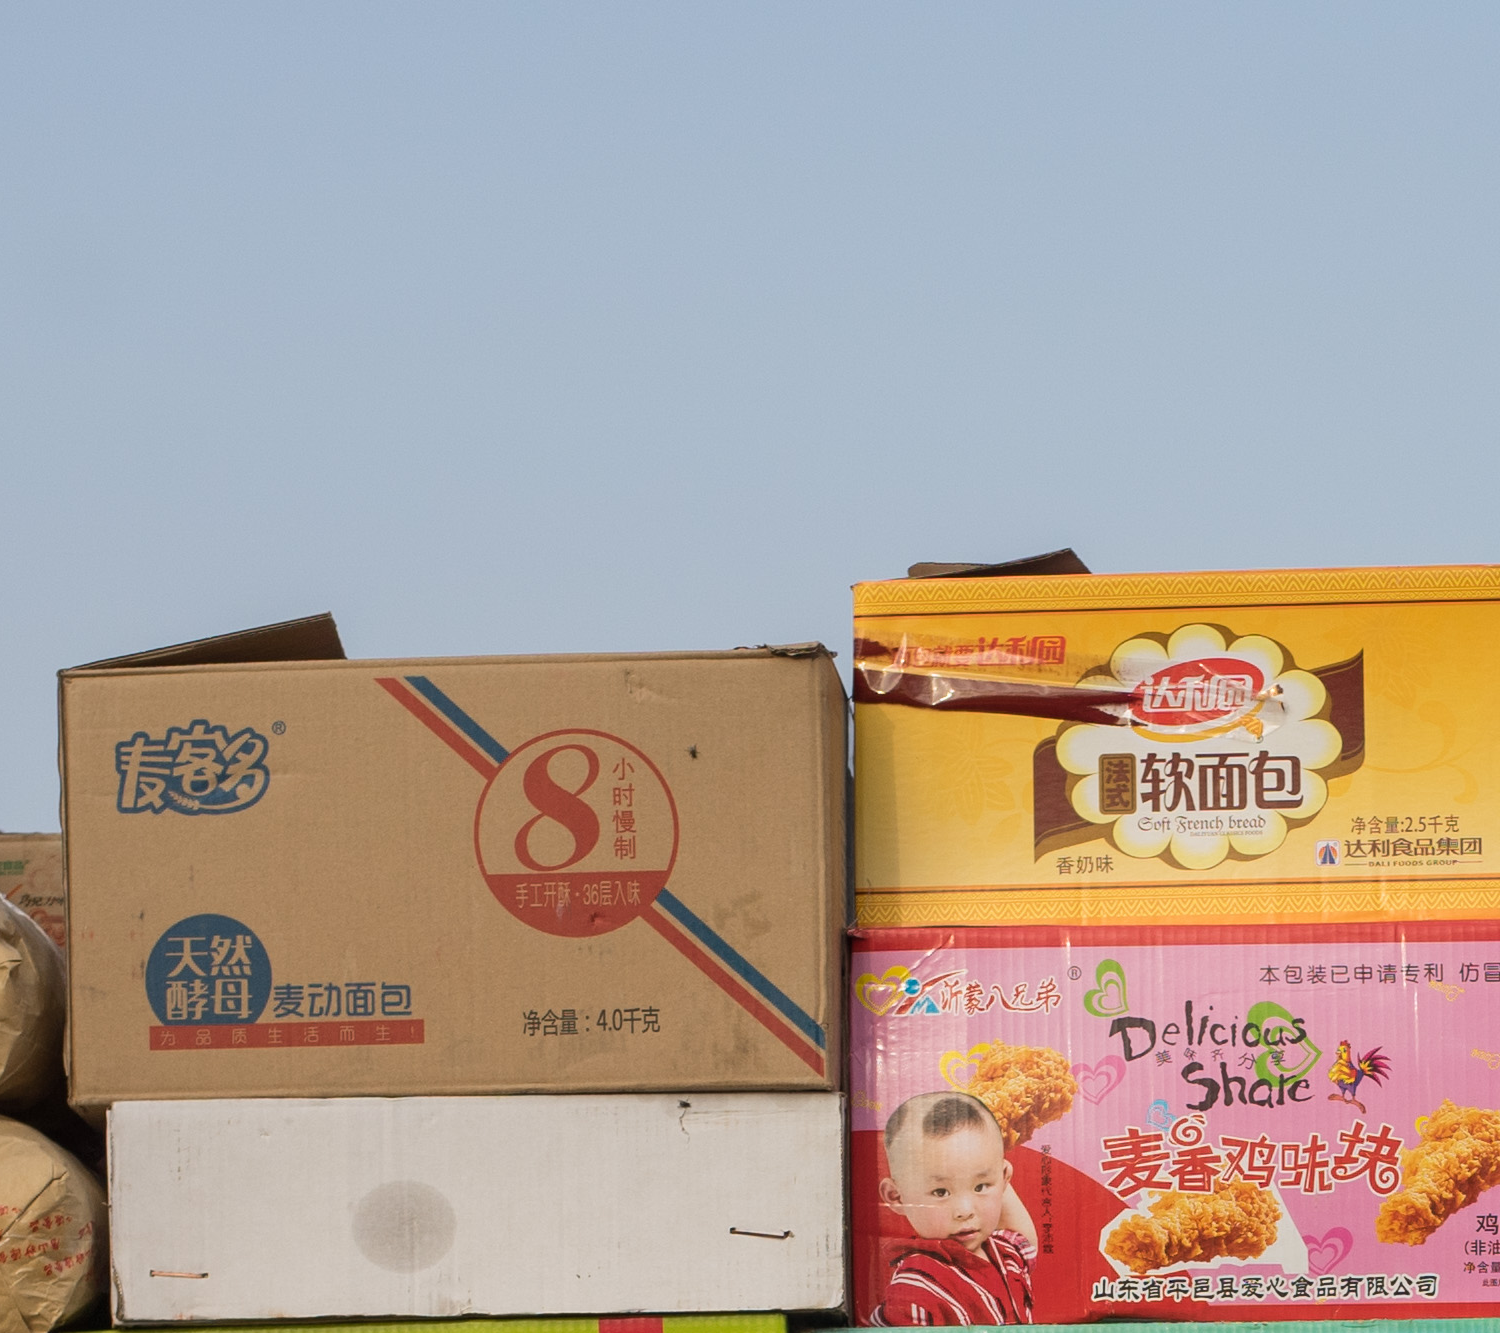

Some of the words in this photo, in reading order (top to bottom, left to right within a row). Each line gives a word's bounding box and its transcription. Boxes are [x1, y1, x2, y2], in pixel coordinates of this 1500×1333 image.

[1141, 673, 1255, 715] 达利园
[115, 720, 270, 816] 麦客多
[1105, 759, 1131, 809] 法式
[1141, 753, 1303, 811] 软面包
[514, 743, 601, 871] 8
[612, 758, 638, 862] 小时慢制
[1138, 816, 1171, 832] Soft
[1175, 816, 1224, 833] French
[1229, 814, 1266, 830] bread
[1351, 815, 1460, 834] 净含量:2.5千克
[1056, 854, 1113, 875] 香奶味
[1344, 837, 1482, 858] 达利食品集团
[166, 935, 252, 975] 天然
[1259, 962, 1444, 984] 本包装已申请专利
[166, 980, 252, 1021] 酵母
[273, 983, 412, 1018] 麦动面包
[1110, 1001, 1307, 1061] Delicious
[1186, 1063, 1315, 1111] Share
[1102, 1116, 1404, 1194] 麦香鸡味块
[1092, 1275, 1439, 1302] 山东省平邑县爱心食品有限公司
